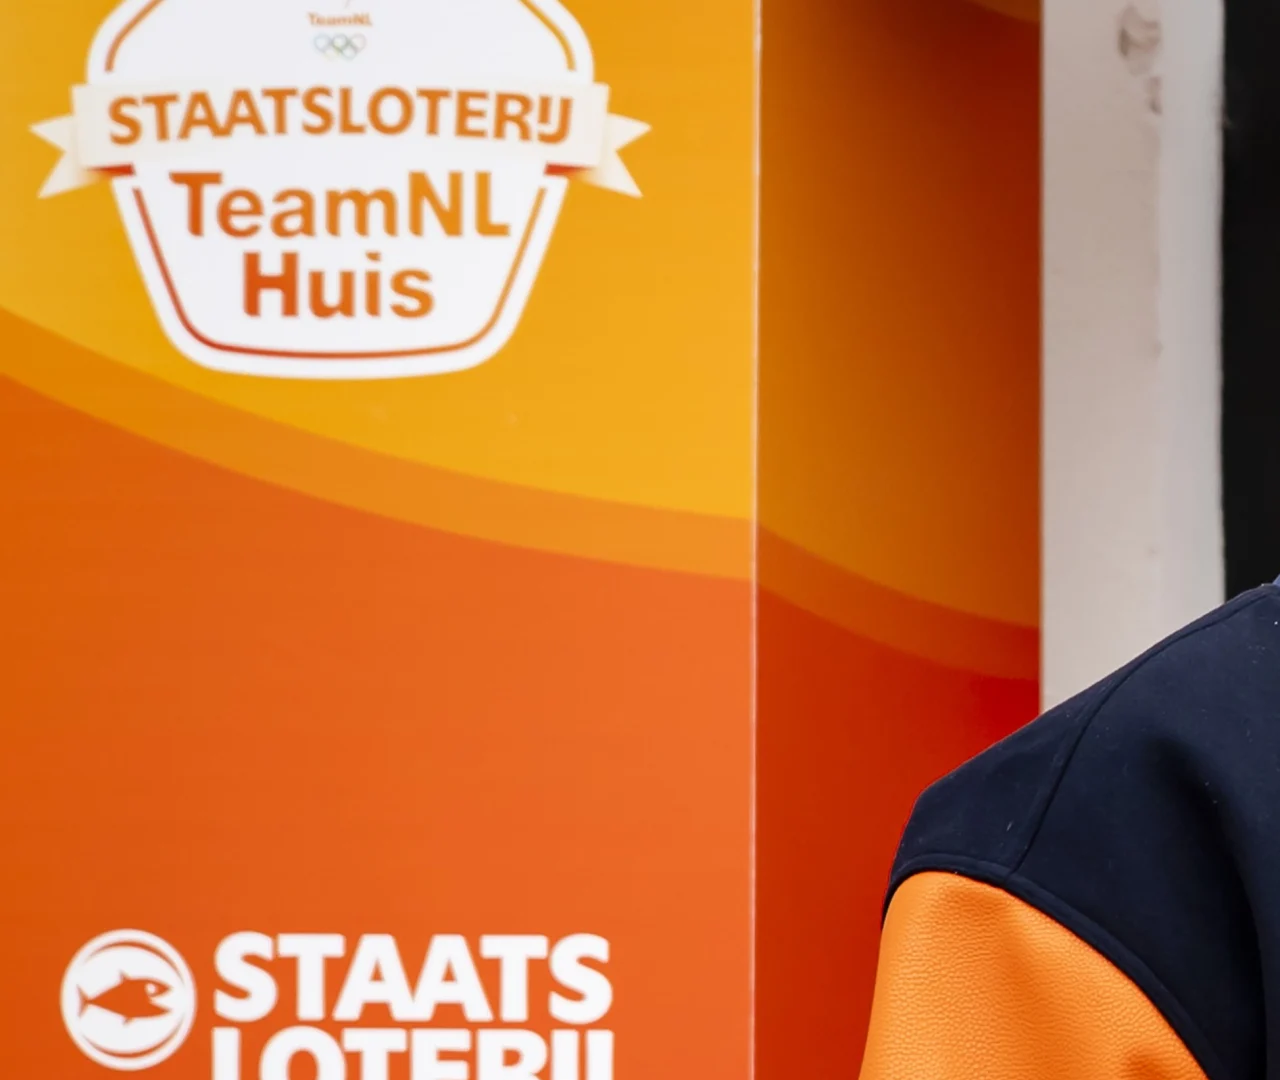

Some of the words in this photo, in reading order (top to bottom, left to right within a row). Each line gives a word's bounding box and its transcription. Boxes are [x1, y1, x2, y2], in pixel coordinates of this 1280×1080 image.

[108, 86, 573, 145] STAATSLOTERIJ
[169, 171, 510, 239] TeamNL
[243, 251, 434, 319] Huis
[215, 931, 613, 1023] STAATS
